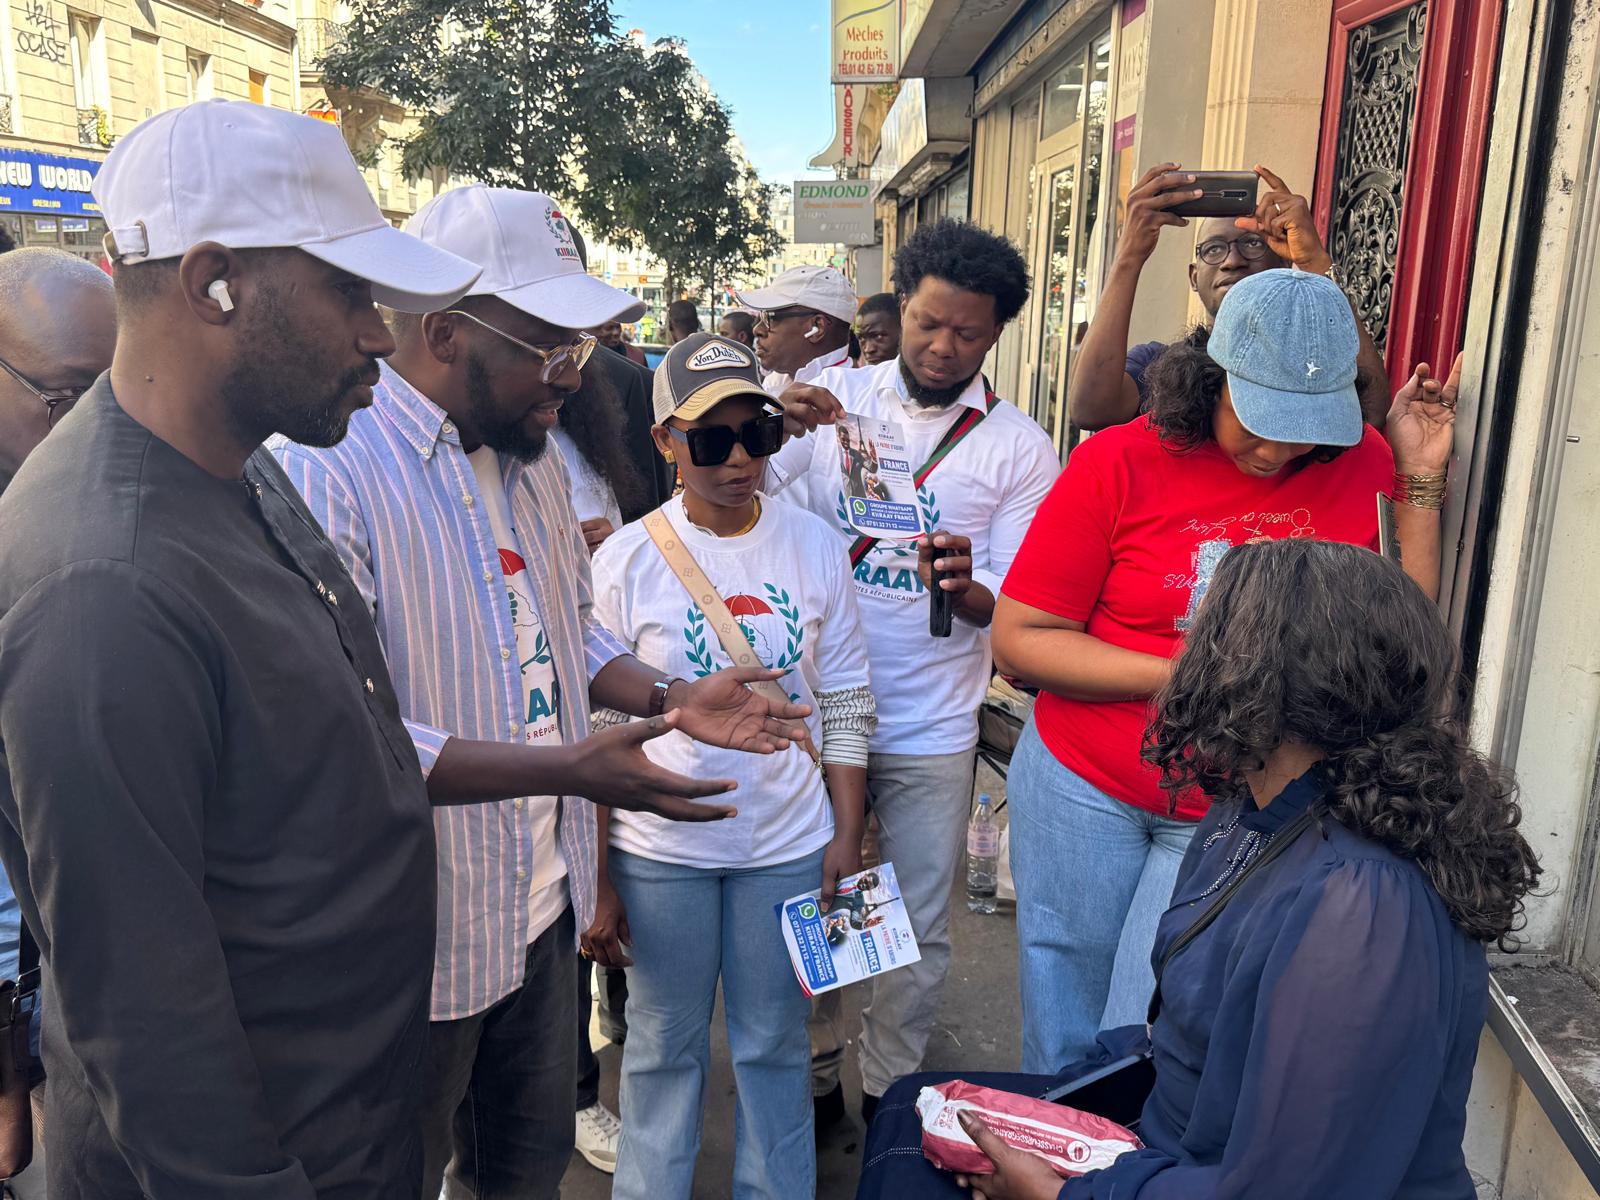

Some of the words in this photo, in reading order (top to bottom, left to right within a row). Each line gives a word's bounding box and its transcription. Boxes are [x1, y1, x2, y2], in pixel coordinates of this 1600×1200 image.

[38, 165, 92, 193] WORLD
[800, 185, 868, 198] EDMOND
[884, 460, 908, 471] FRANCE
[854, 560, 923, 593] RAAY
[815, 924, 824, 946] GROUPE
[820, 946, 834, 979] WHATSAPP
[863, 936, 880, 974] FRANCE
[815, 955, 826, 981] FRANCE
